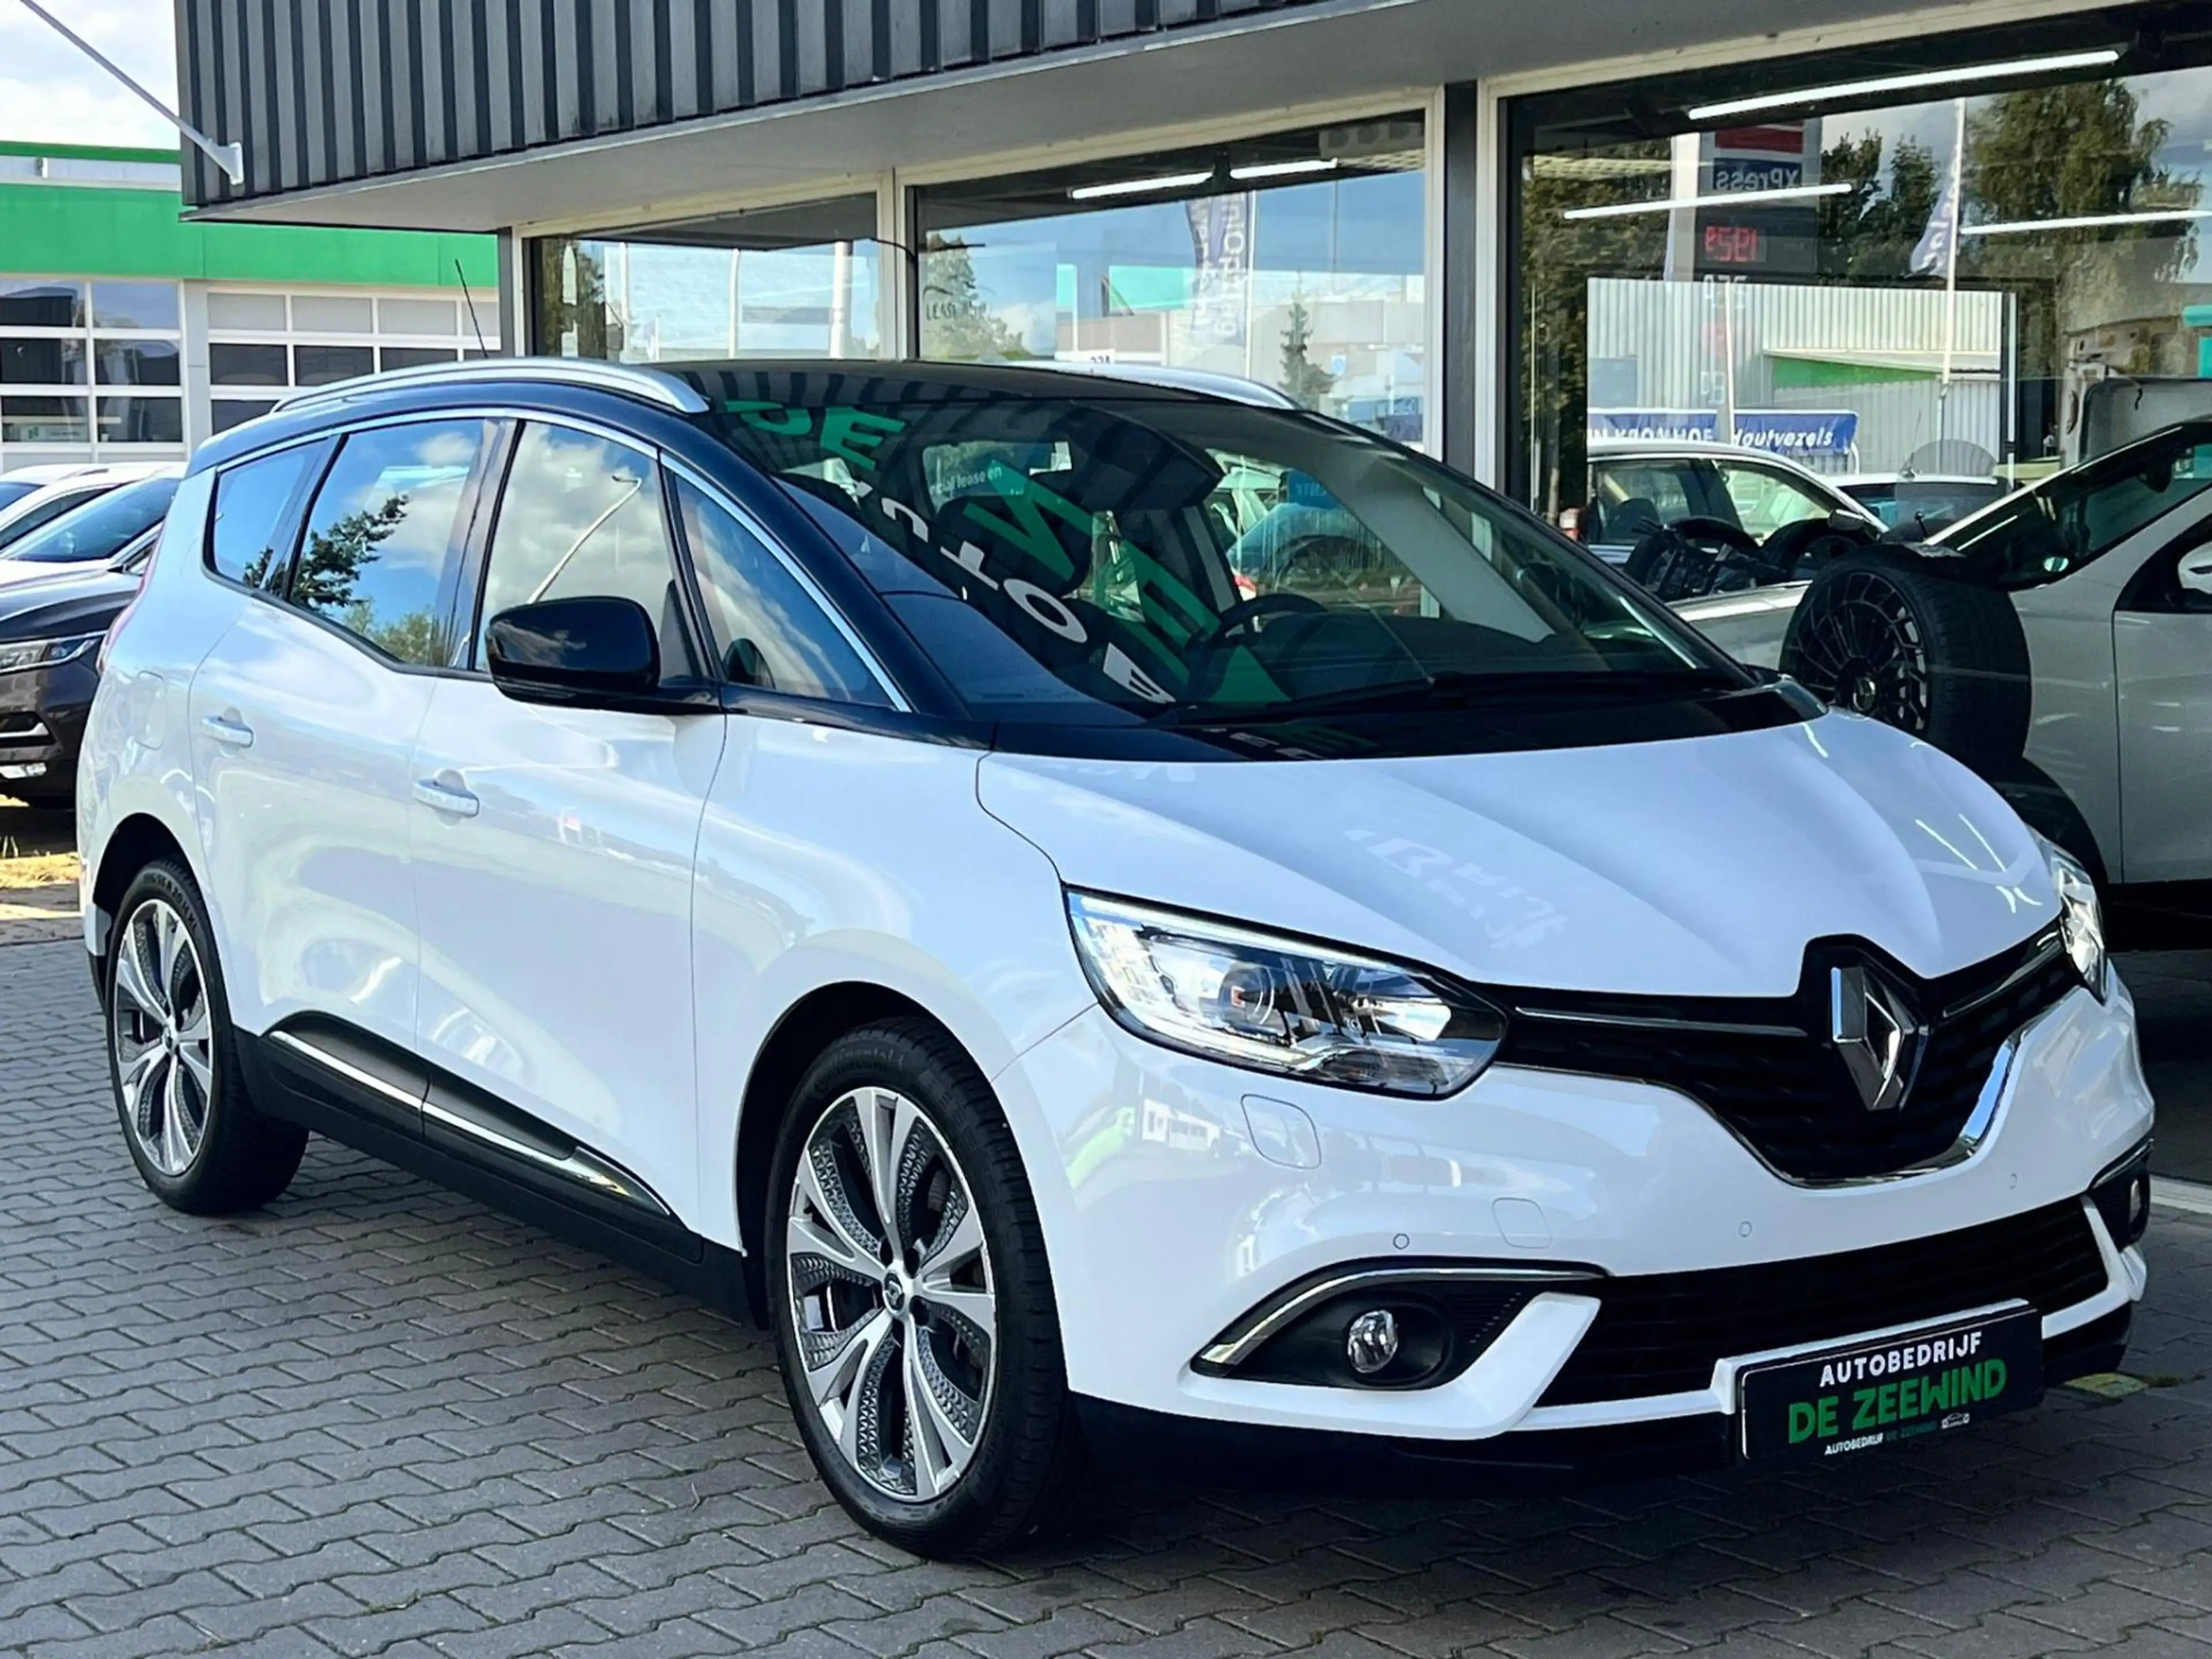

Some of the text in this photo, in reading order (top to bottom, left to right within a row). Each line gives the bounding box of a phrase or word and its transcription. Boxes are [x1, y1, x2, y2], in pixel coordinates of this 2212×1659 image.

[1819, 1331, 1982, 1388] AUTOBEDRIJF
[1789, 1358, 2007, 1444] DE ZEEWIND
